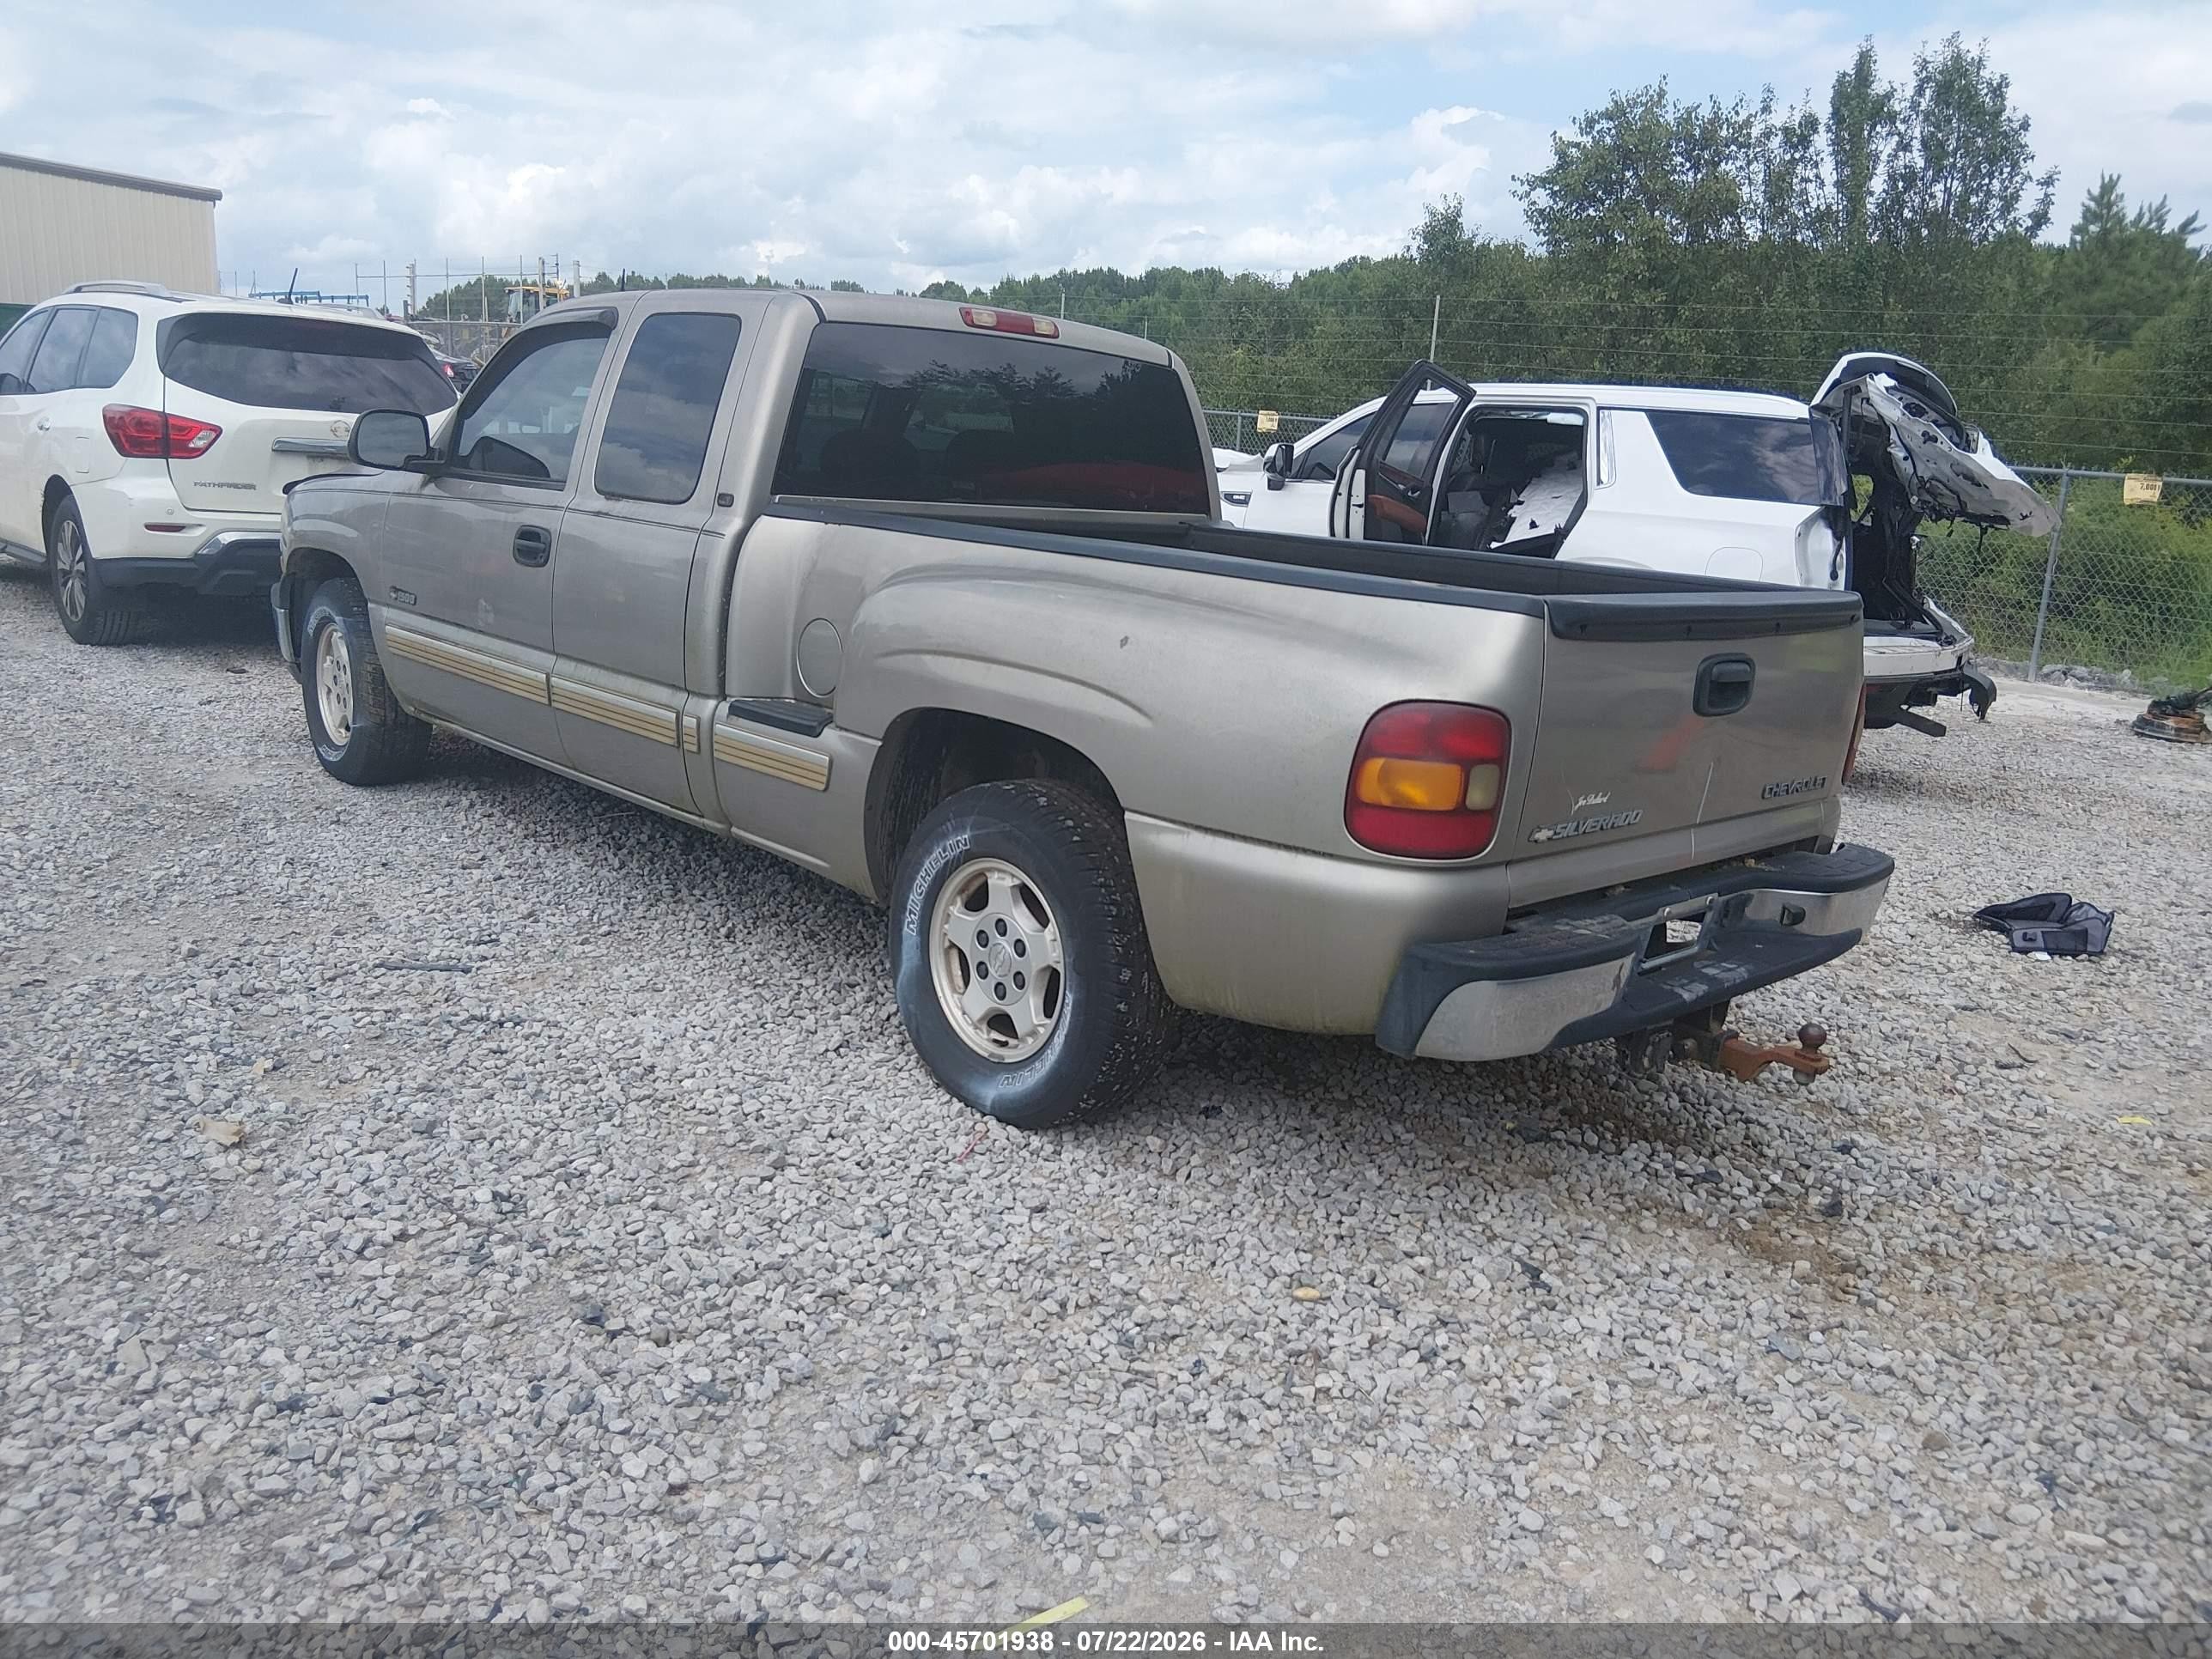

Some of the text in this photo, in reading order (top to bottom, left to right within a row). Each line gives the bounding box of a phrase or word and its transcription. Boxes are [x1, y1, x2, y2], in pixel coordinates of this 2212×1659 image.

[1763, 775, 1827, 798] CHEVROLET
[1553, 809, 1644, 839] SILVERADO
[904, 834, 971, 936] MICHELIN
